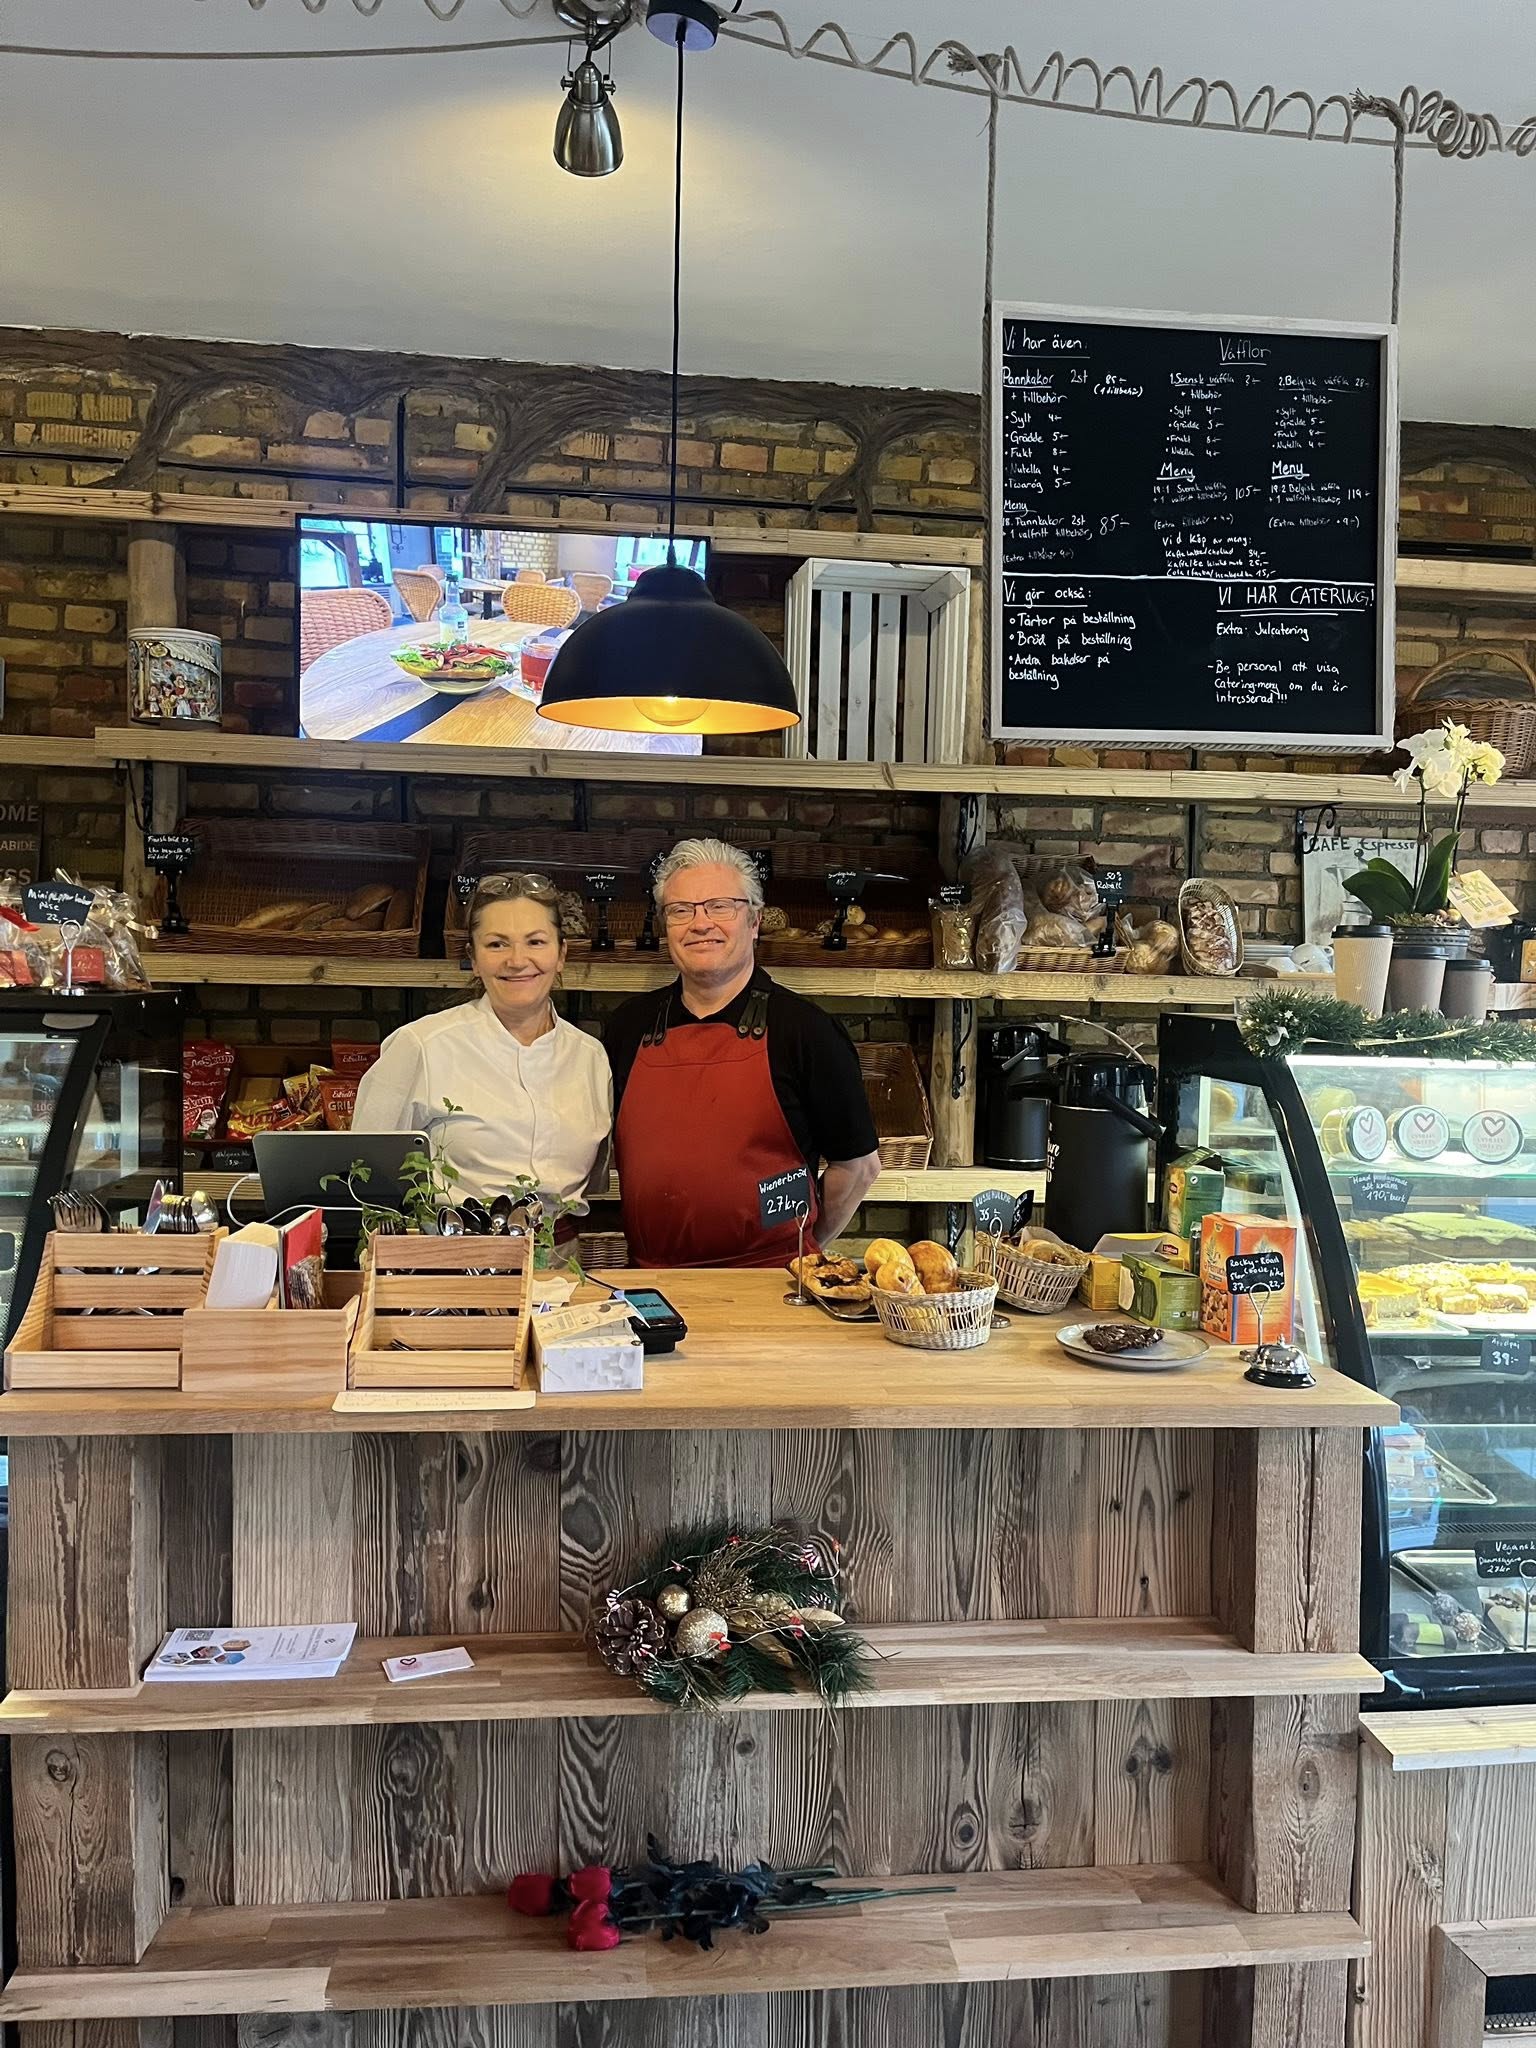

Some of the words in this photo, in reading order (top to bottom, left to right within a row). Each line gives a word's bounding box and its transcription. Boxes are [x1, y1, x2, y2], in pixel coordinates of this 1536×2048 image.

[1004, 325, 1016, 351] Vi
[1022, 327, 1046, 350] har
[1002, 366, 1054, 385] Pannkakor
[1070, 369, 1088, 384] 2st
[1010, 411, 1031, 428] Sylt
[1174, 405, 1192, 419] Sylt
[1010, 431, 1044, 445] Grädde
[1160, 461, 1195, 482] Meny
[1272, 460, 1304, 480] Meny
[1004, 500, 1029, 516] Meny
[1004, 579, 1016, 602] Vi
[1025, 588, 1045, 608] gör
[1219, 586, 1232, 605] VI
[1247, 585, 1278, 605] HAR
[1290, 585, 1375, 607] CATERING!
[1063, 615, 1077, 630] på
[1083, 611, 1136, 630] beställning
[1017, 631, 1046, 646] Bröd
[1057, 634, 1070, 650] på
[1081, 632, 1133, 651] beställning
[1255, 622, 1310, 641] Julcatering
[1014, 653, 1041, 666] Andra
[1097, 652, 1110, 668] på
[1237, 660, 1281, 676] personal
[1292, 661, 1307, 671] att
[1316, 660, 1339, 675] visa
[1009, 667, 1060, 691] beställning
[1289, 682, 1303, 691] om
[1311, 680, 1323, 691] du
[1332, 679, 1348, 691] är
[1359, 838, 1417, 858] Espresso
[758, 1168, 807, 1195] Wienerbröd
